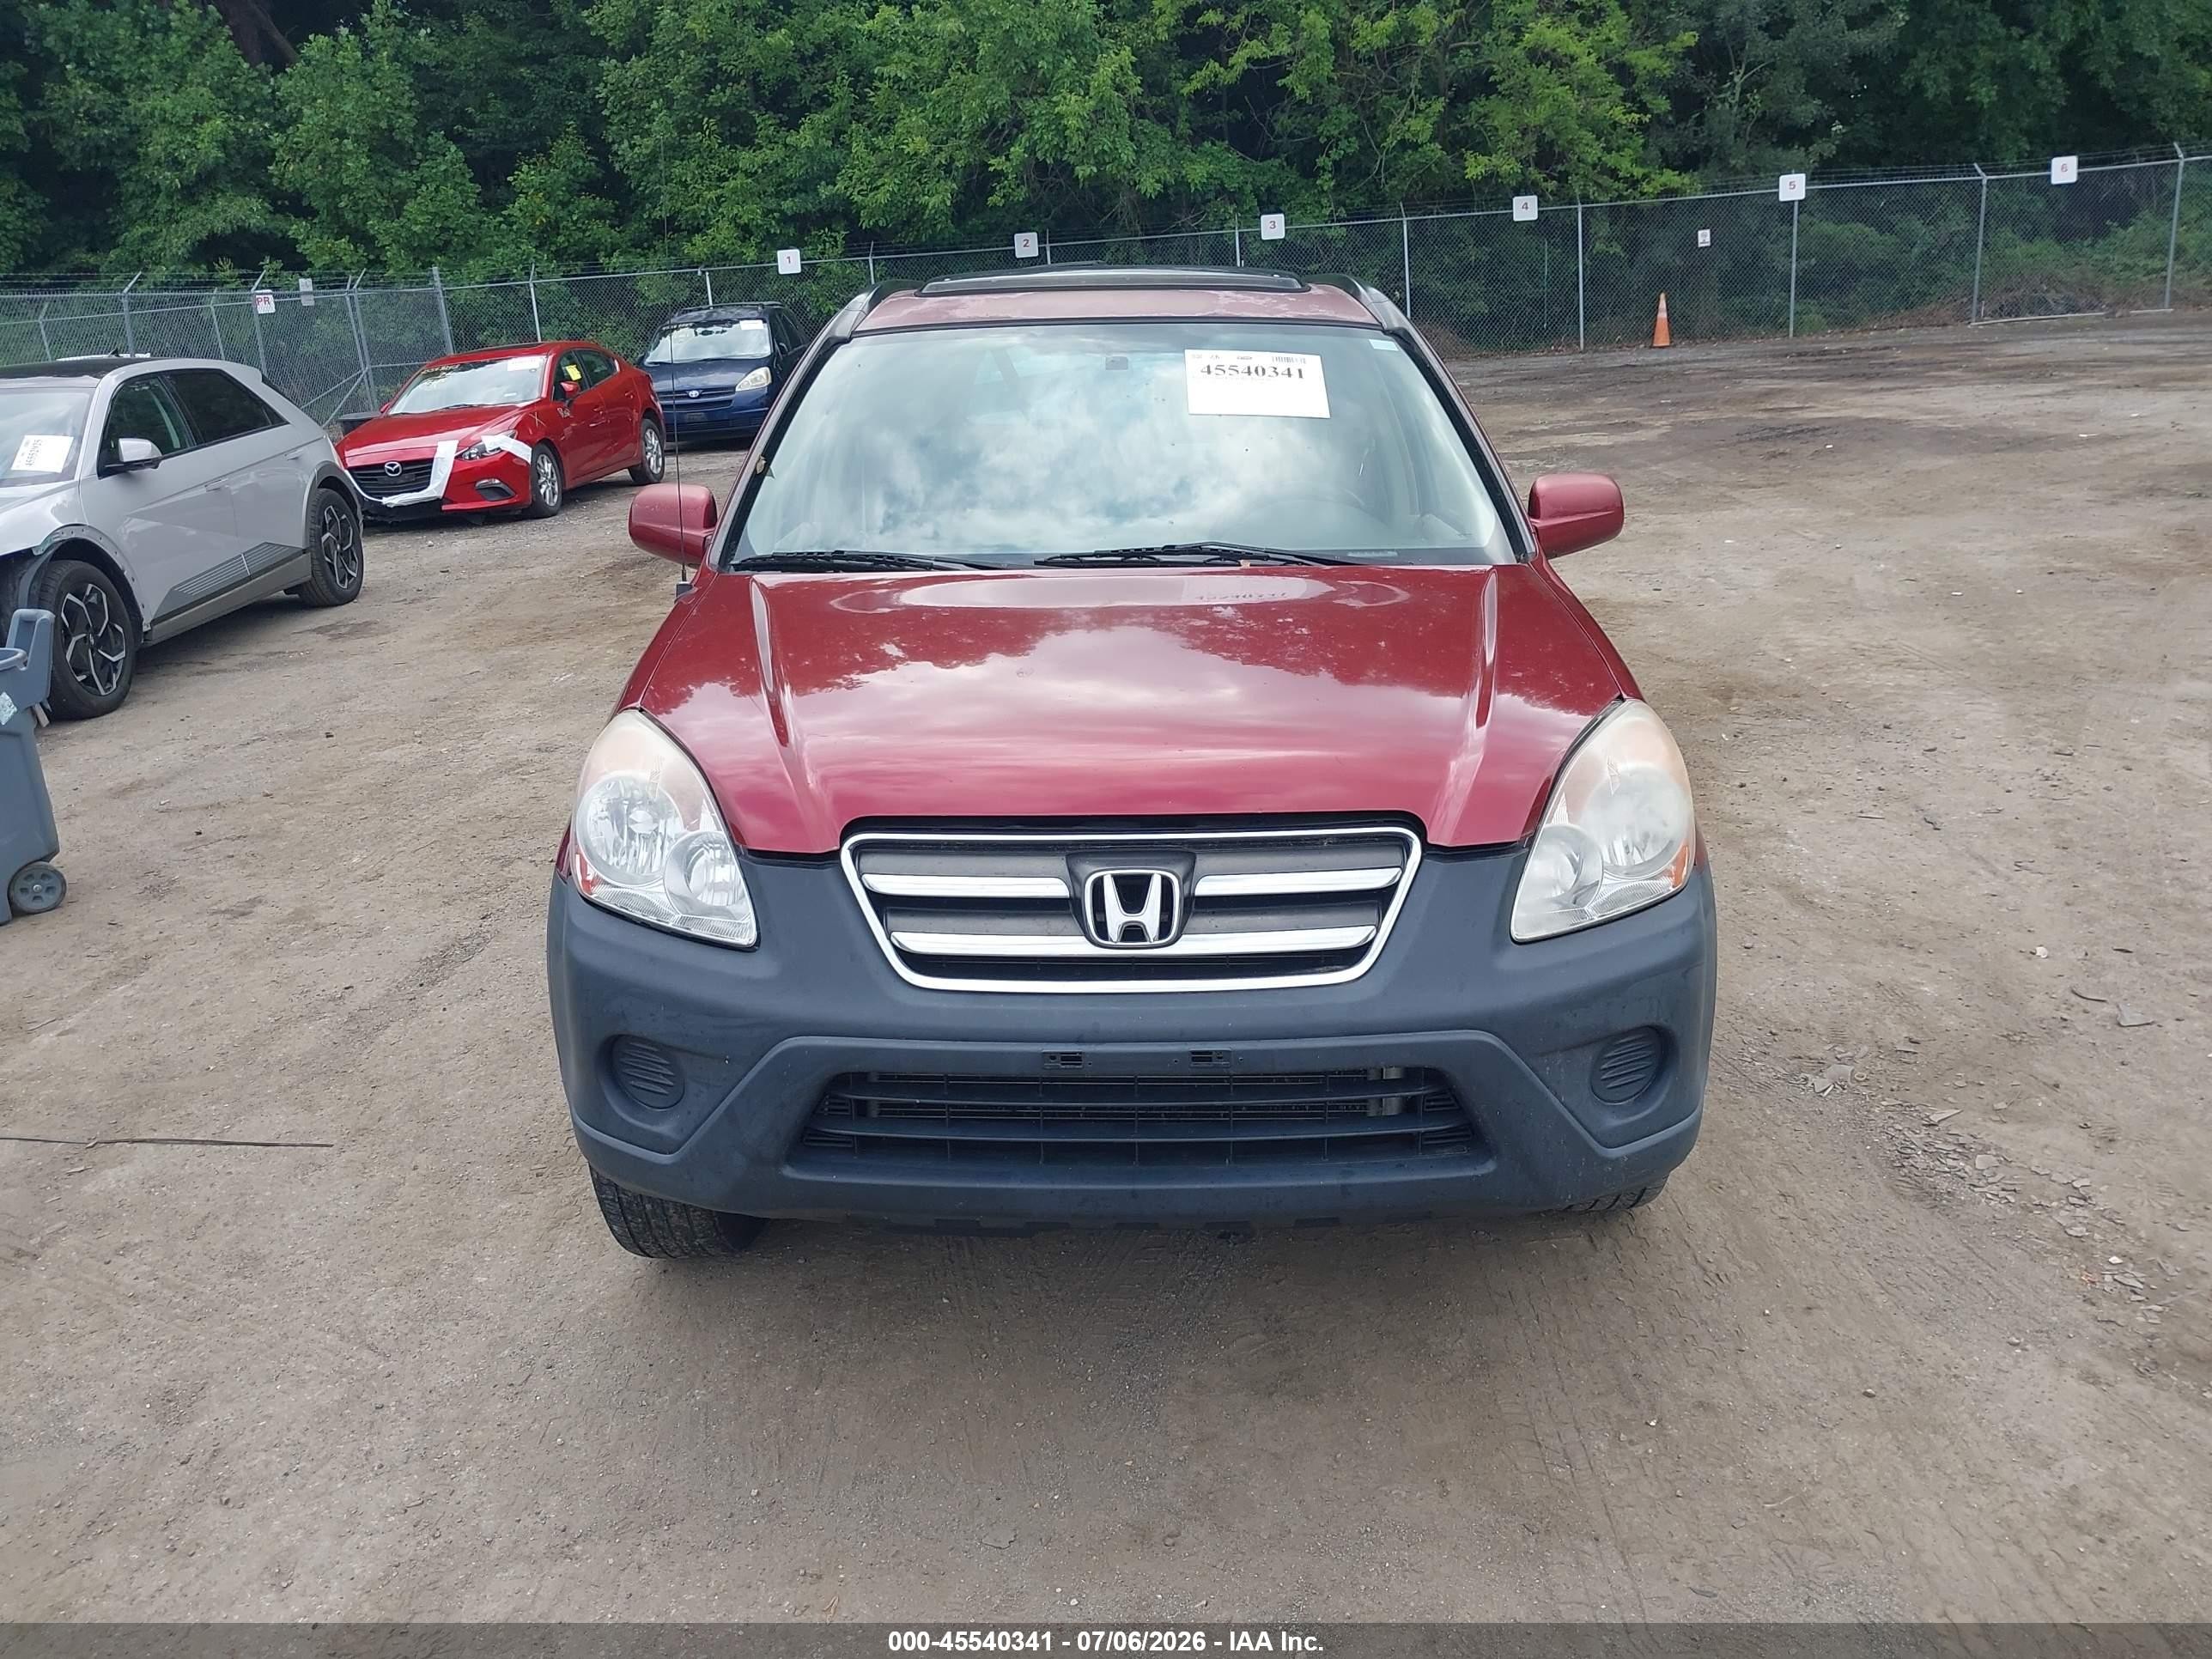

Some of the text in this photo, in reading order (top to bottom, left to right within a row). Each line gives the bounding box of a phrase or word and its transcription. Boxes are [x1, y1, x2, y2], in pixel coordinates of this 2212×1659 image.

[2061, 163, 2068, 172] 6
[1789, 181, 1796, 190] 5
[1522, 202, 1528, 210] 4
[1269, 221, 1276, 229] 3
[1023, 239, 1030, 247] 2
[257, 297, 270, 306] PR
[1200, 364, 1304, 379] 45540341
